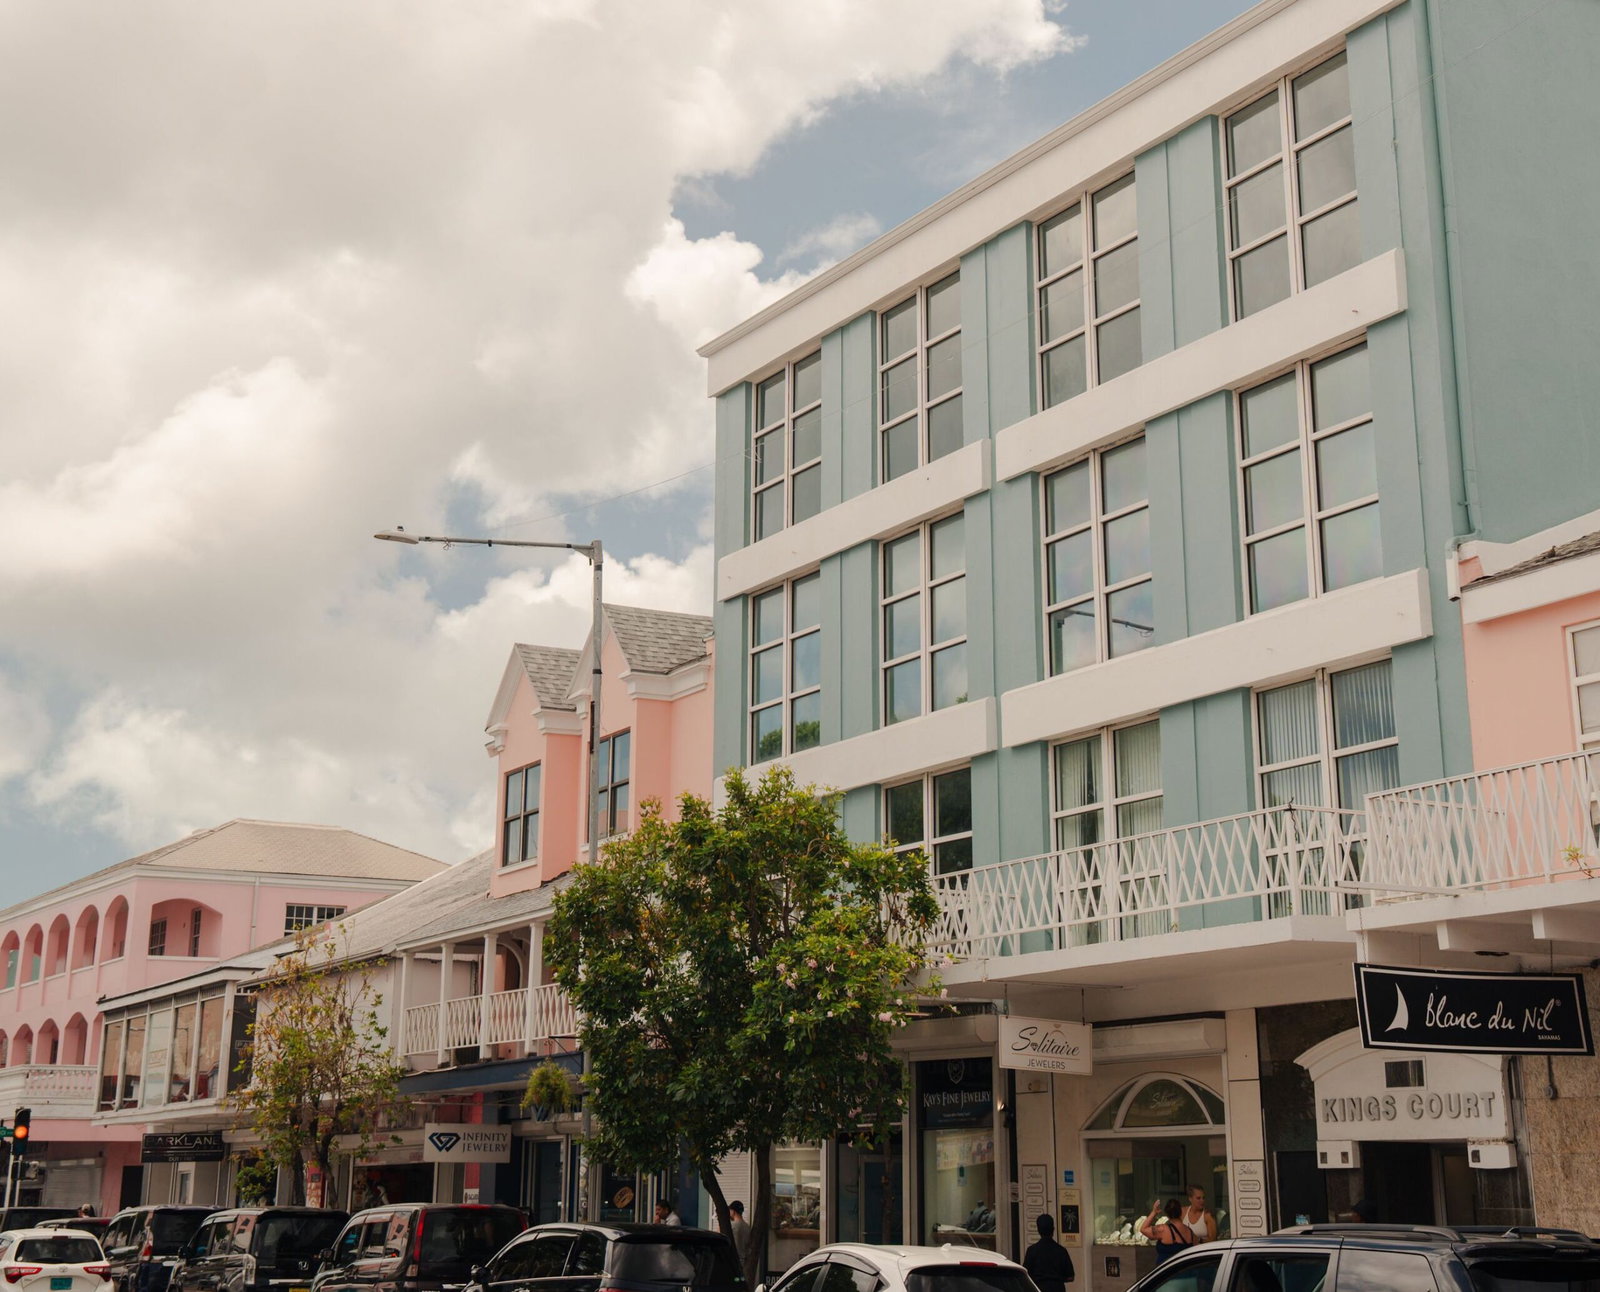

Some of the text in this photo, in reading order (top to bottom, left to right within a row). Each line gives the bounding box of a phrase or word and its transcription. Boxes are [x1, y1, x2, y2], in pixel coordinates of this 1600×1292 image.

[1425, 992, 1482, 1029] Blanc
[1488, 1001, 1516, 1030] du
[1027, 1058, 1066, 1070] JEWELERS
[1322, 1091, 1496, 1123] KINGS COURT
[463, 1132, 507, 1142] INFINITY
[462, 1143, 507, 1153] JEWELRY
